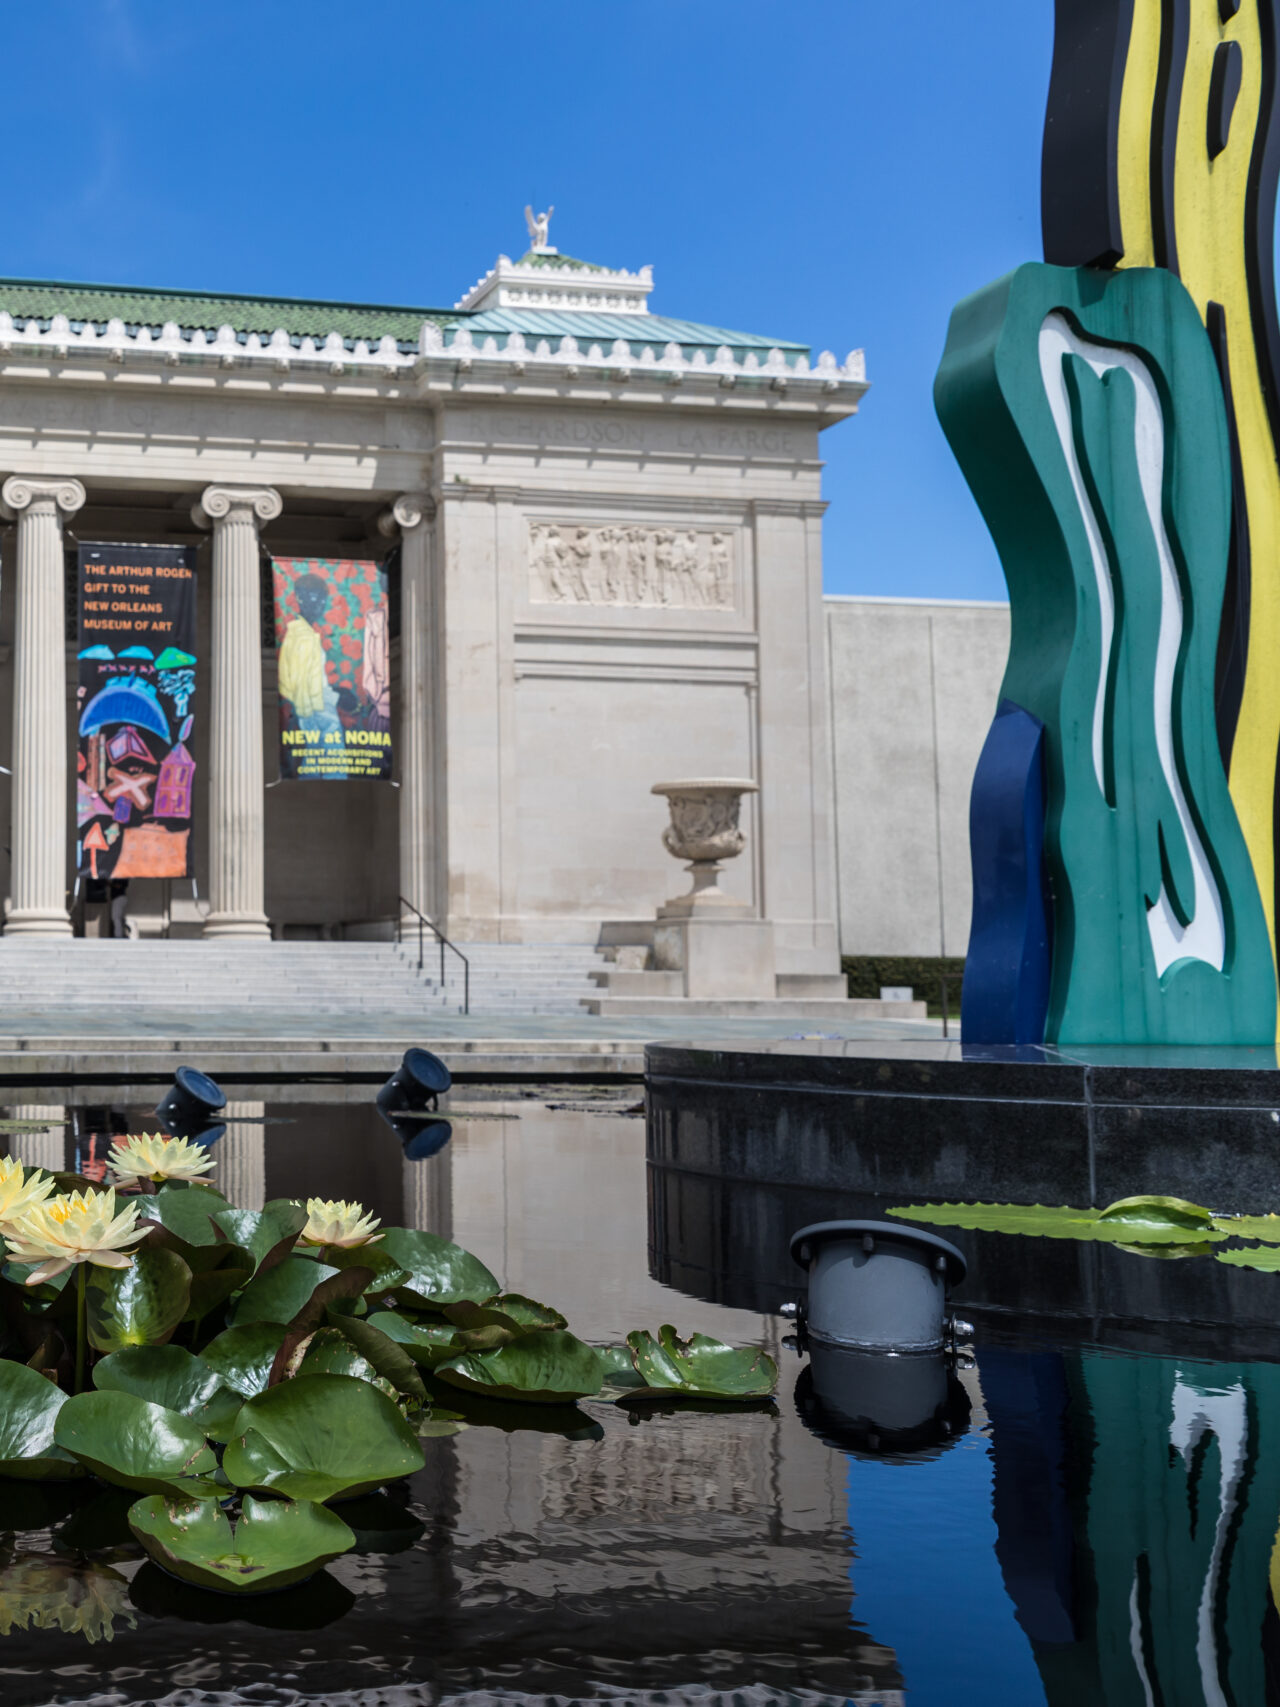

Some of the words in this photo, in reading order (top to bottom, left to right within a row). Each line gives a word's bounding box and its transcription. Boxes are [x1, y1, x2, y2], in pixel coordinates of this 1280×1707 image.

[469, 416, 645, 444] RICHARDSON
[84, 564, 106, 576] THE
[108, 565, 153, 578] ARTHUR
[83, 582, 109, 594] GIFT
[111, 583, 127, 595] TO
[128, 584, 151, 596] THE
[83, 601, 109, 612] NEW
[111, 601, 164, 614] ORLEANS
[83, 619, 132, 631] MUSEUM
[134, 620, 149, 632] OF
[151, 621, 174, 632] ART
[281, 730, 321, 745] NEW
[324, 732, 342, 744] at
[344, 730, 392, 747] NOMA
[291, 748, 325, 757] RECENT
[327, 748, 384, 759] ACQUISITIONS
[305, 757, 316, 765] IN
[317, 757, 354, 766] MODERN
[354, 758, 373, 767] AND
[297, 766, 366, 776] CONTEMPORARY
[365, 767, 382, 776] ART
